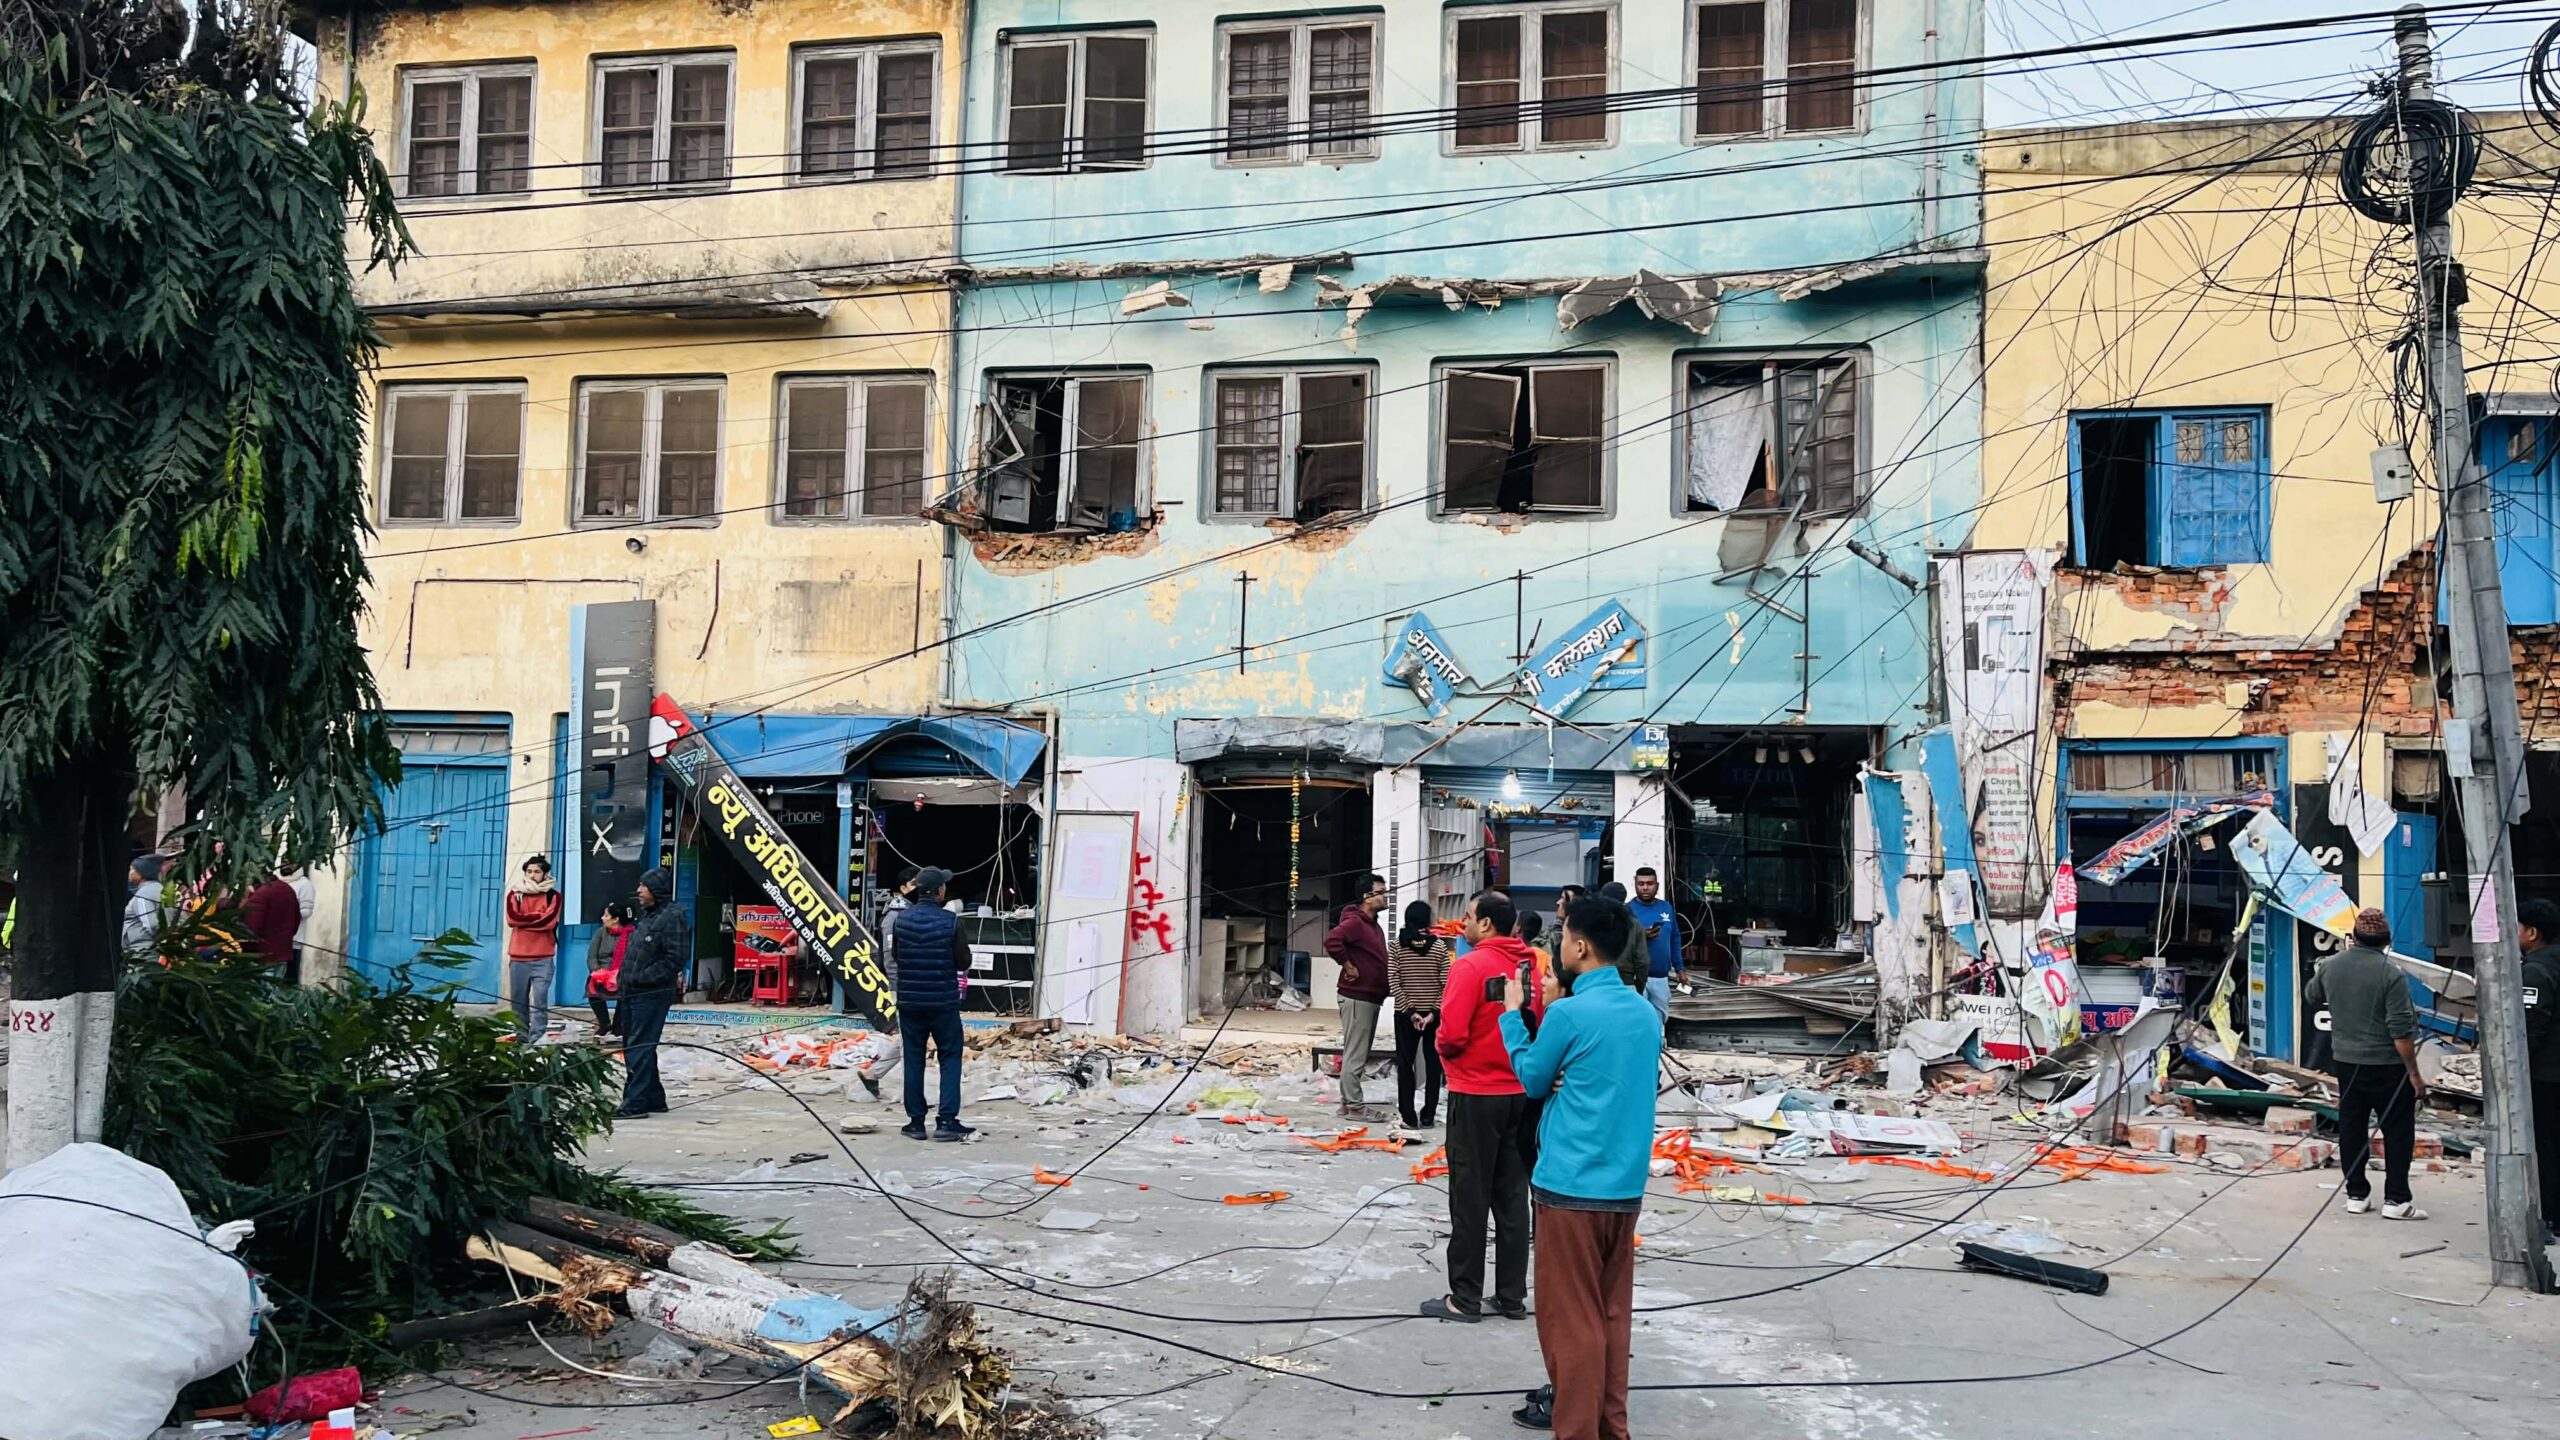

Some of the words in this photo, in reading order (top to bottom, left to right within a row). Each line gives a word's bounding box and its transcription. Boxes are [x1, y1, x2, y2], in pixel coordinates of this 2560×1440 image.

[708, 778, 752, 840] न्यू
[744, 822, 850, 949] अधिकारी
[762, 879, 796, 918] अधिकारी
[2056, 872, 2068, 906] SPECIAL
[2067, 875, 2077, 904] OFFER
